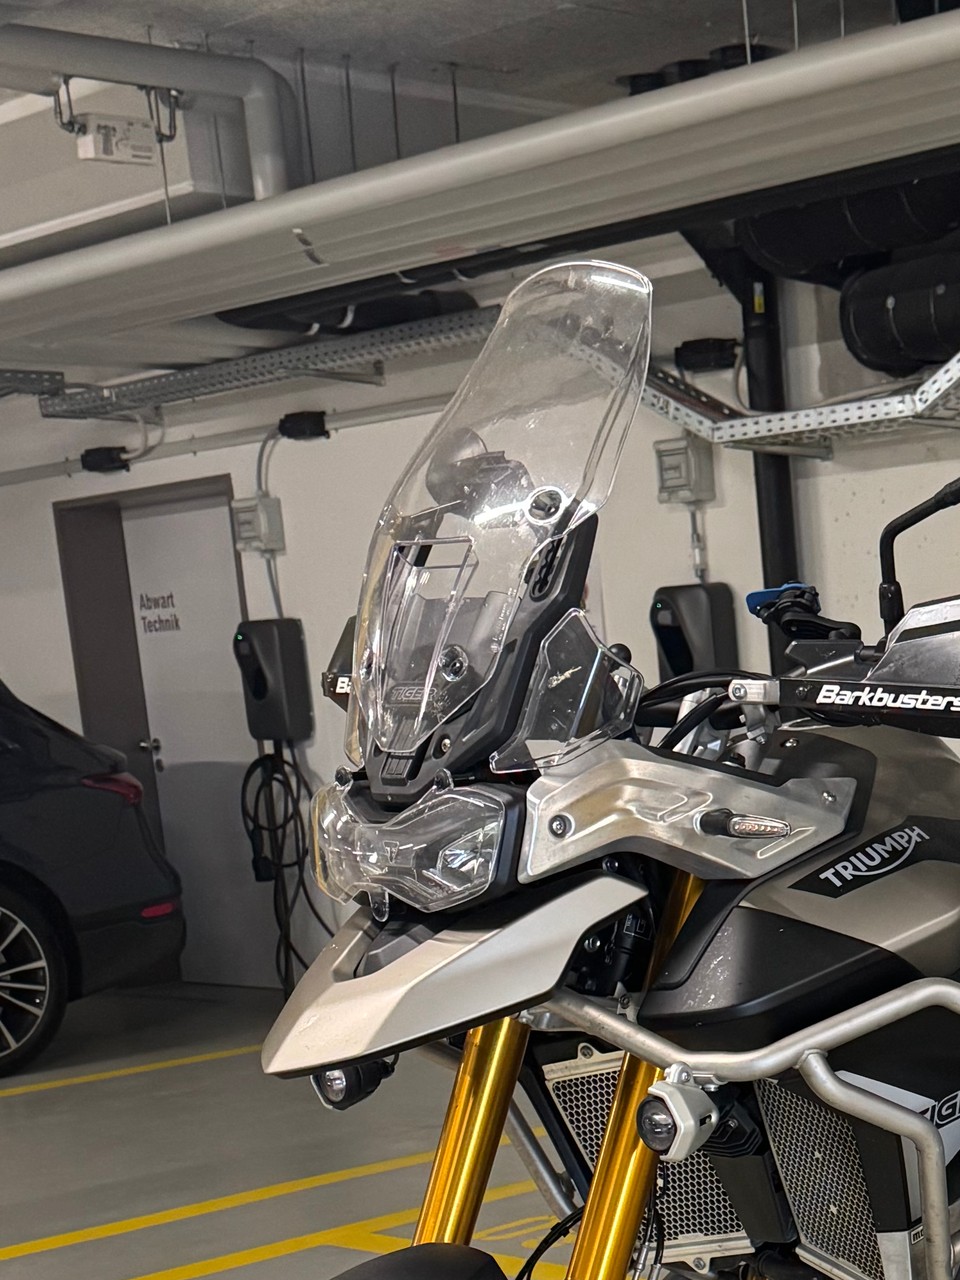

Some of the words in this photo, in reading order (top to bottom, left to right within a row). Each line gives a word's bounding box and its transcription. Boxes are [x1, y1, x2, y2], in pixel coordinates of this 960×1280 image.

[140, 592, 175, 611] Abwart
[141, 613, 181, 633] Technik
[819, 825, 930, 888] TRIUMPH
